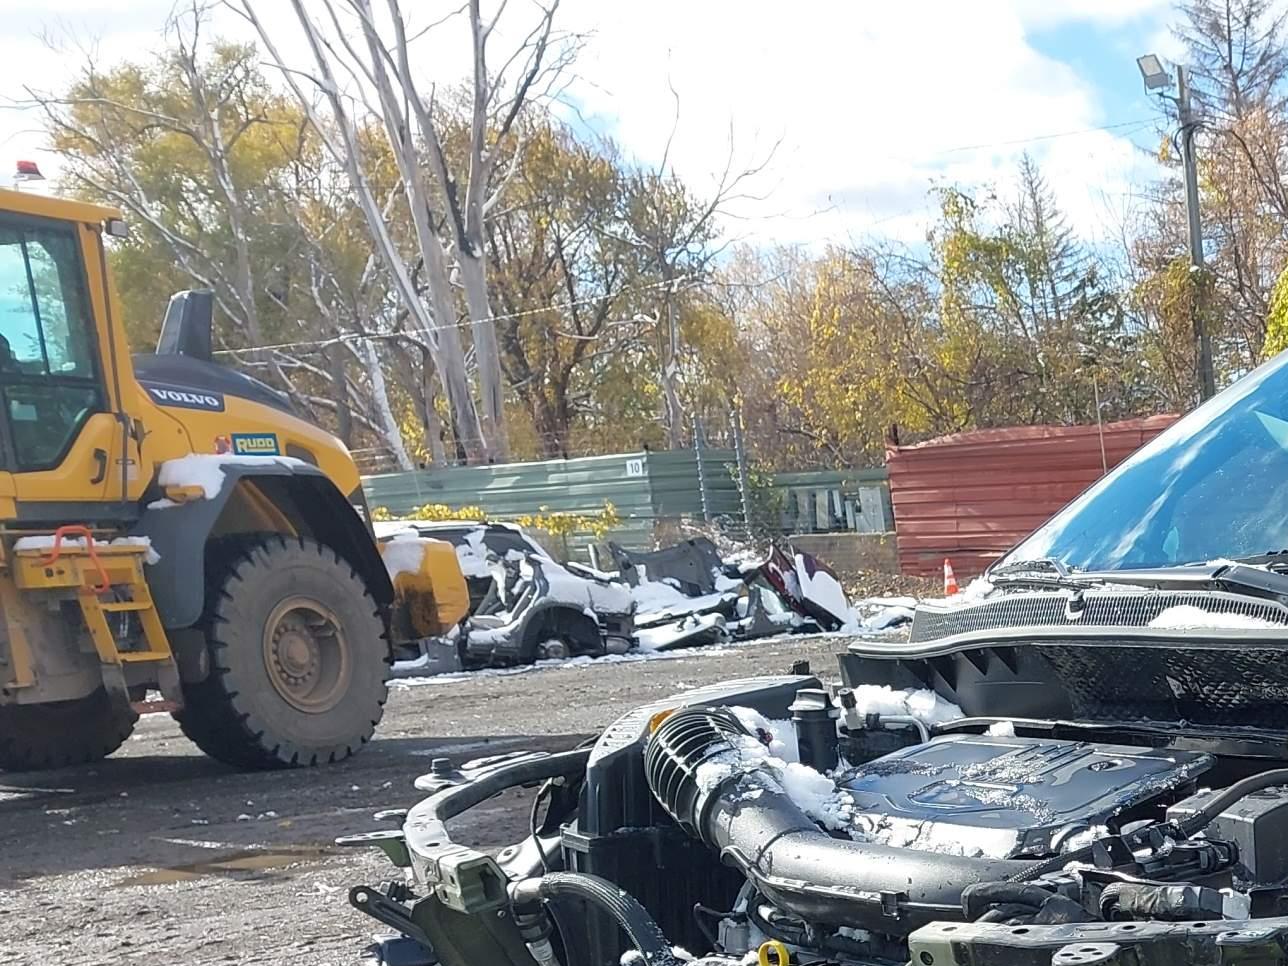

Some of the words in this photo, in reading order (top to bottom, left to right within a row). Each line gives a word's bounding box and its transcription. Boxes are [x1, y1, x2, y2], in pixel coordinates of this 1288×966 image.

[151, 388, 219, 407] VOLVO
[235, 437, 276, 453] RUDD
[630, 462, 640, 474] 10
